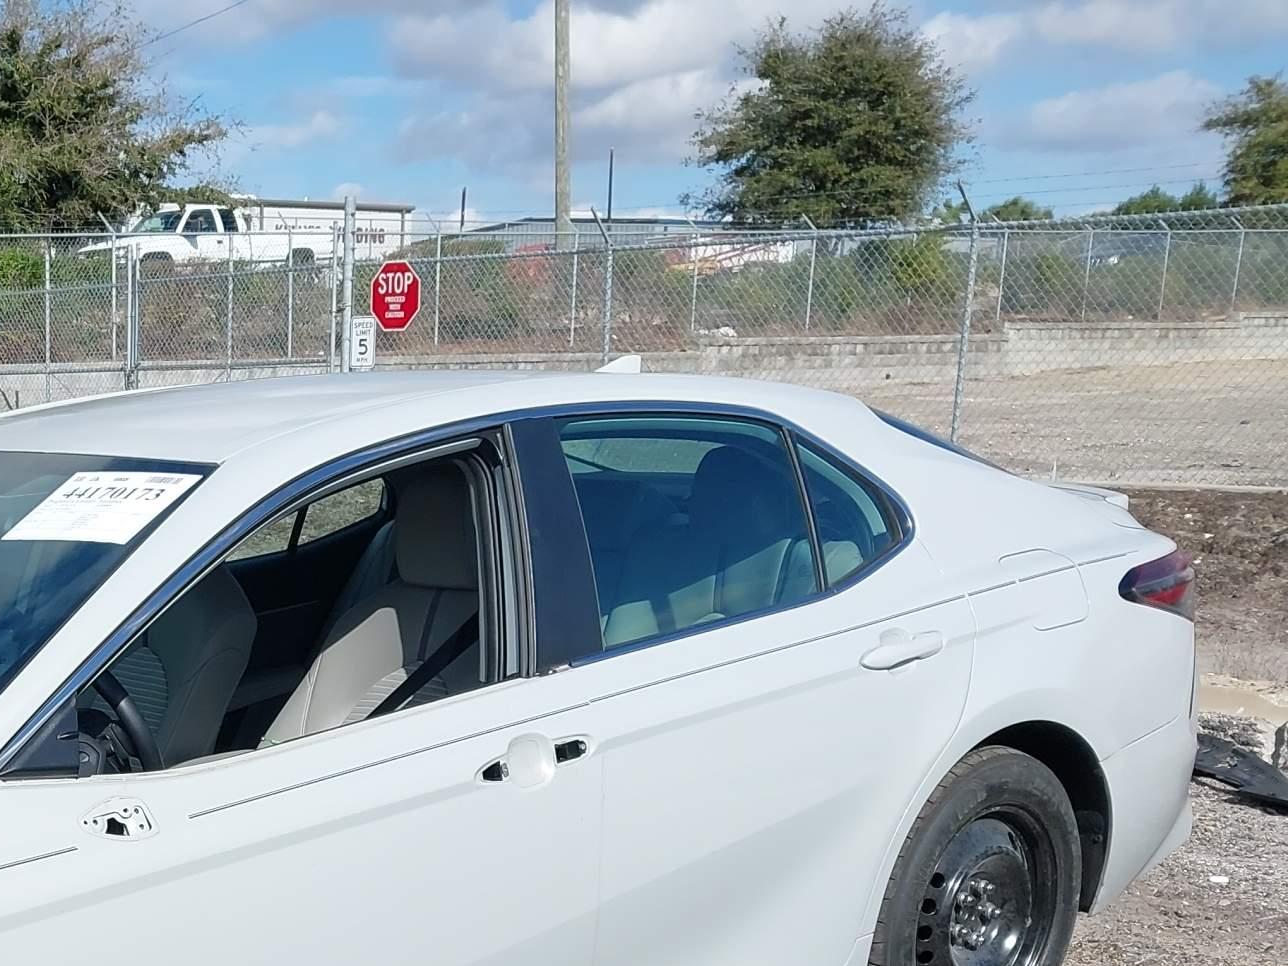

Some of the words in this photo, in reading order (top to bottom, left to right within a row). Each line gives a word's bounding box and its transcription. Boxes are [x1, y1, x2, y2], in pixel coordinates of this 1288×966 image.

[378, 272, 413, 294] STOP
[354, 321, 373, 329] SPEED
[355, 329, 371, 337] LIMIT
[358, 338, 368, 355] 5
[62, 486, 166, 501] 44170173
